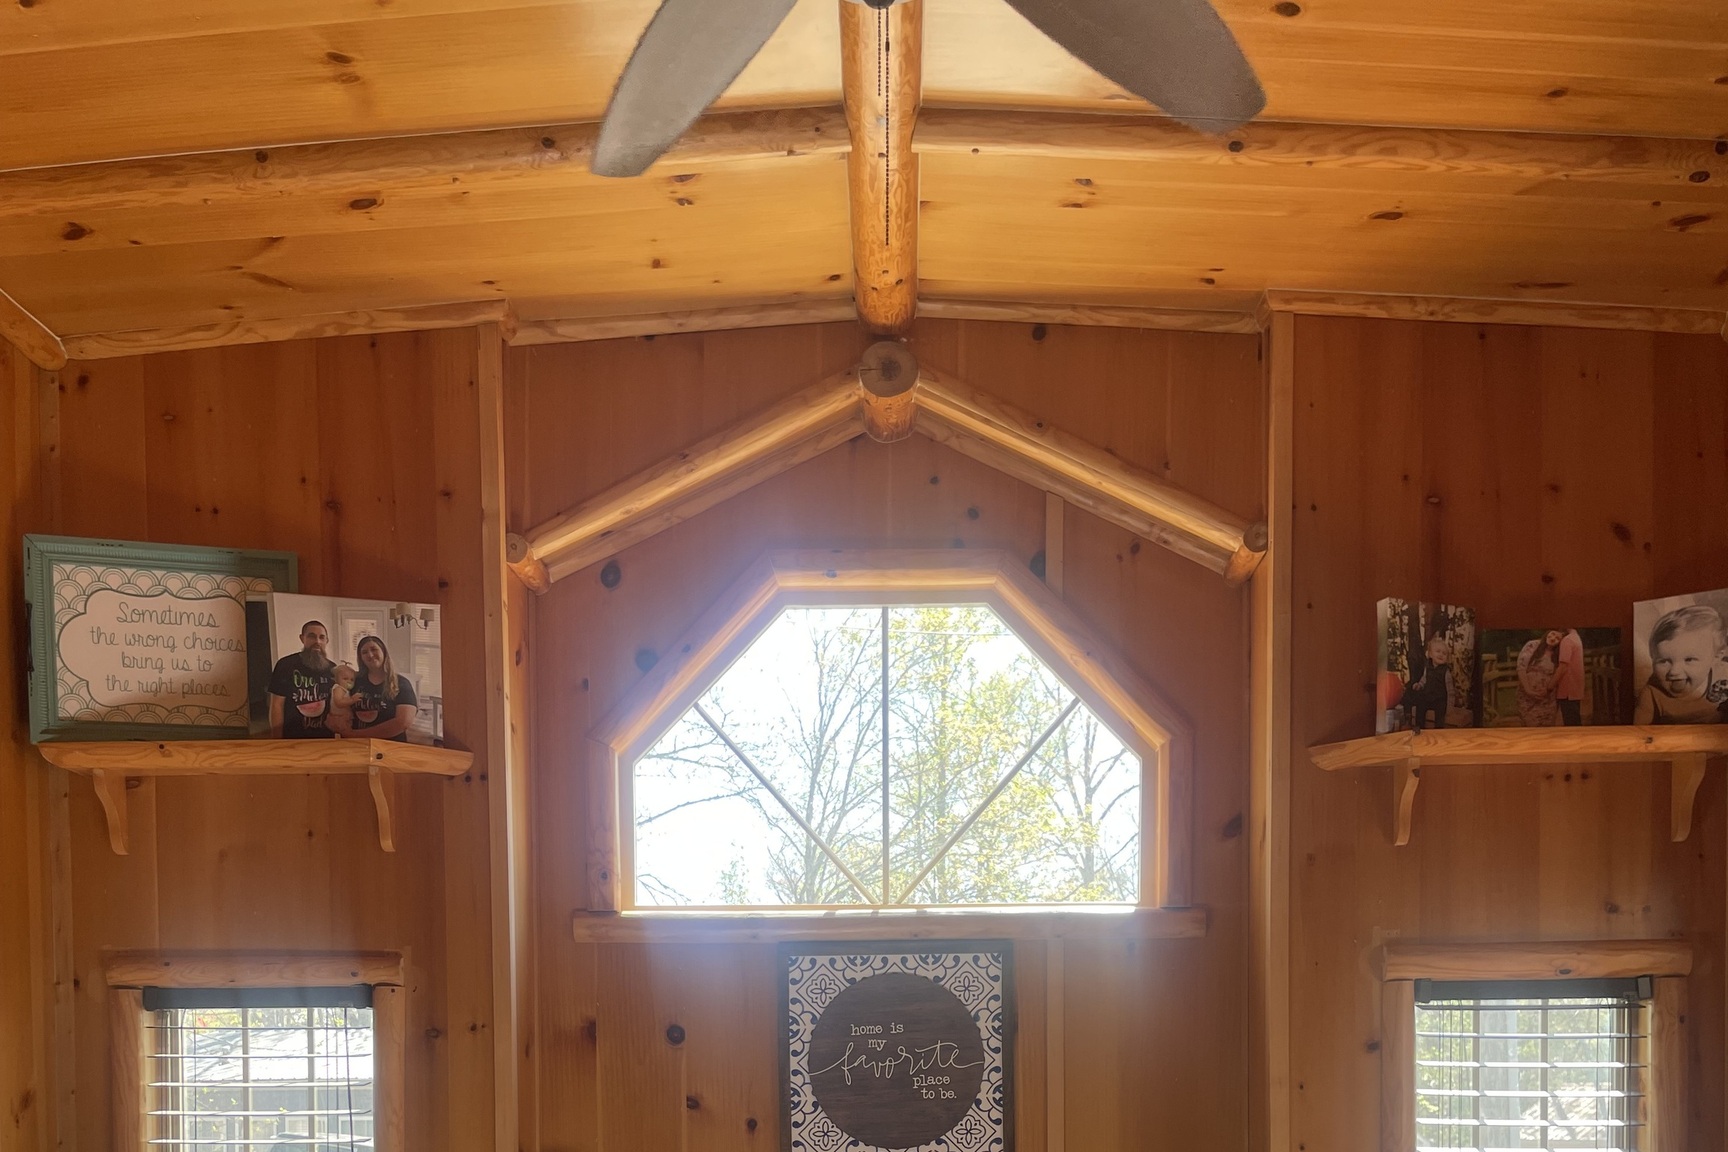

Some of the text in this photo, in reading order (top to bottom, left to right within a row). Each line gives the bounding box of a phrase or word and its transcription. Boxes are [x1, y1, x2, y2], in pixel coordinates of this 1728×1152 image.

[116, 601, 220, 628] Sometimes
[90, 626, 246, 653] the wrong choices
[121, 651, 214, 674] bring us to
[105, 674, 231, 699] the right places
[850, 1022, 904, 1036] home is
[867, 1039, 887, 1051] my
[809, 1040, 985, 1086] favorite
[912, 1074, 951, 1089] place
[920, 1088, 957, 1099] to be.
